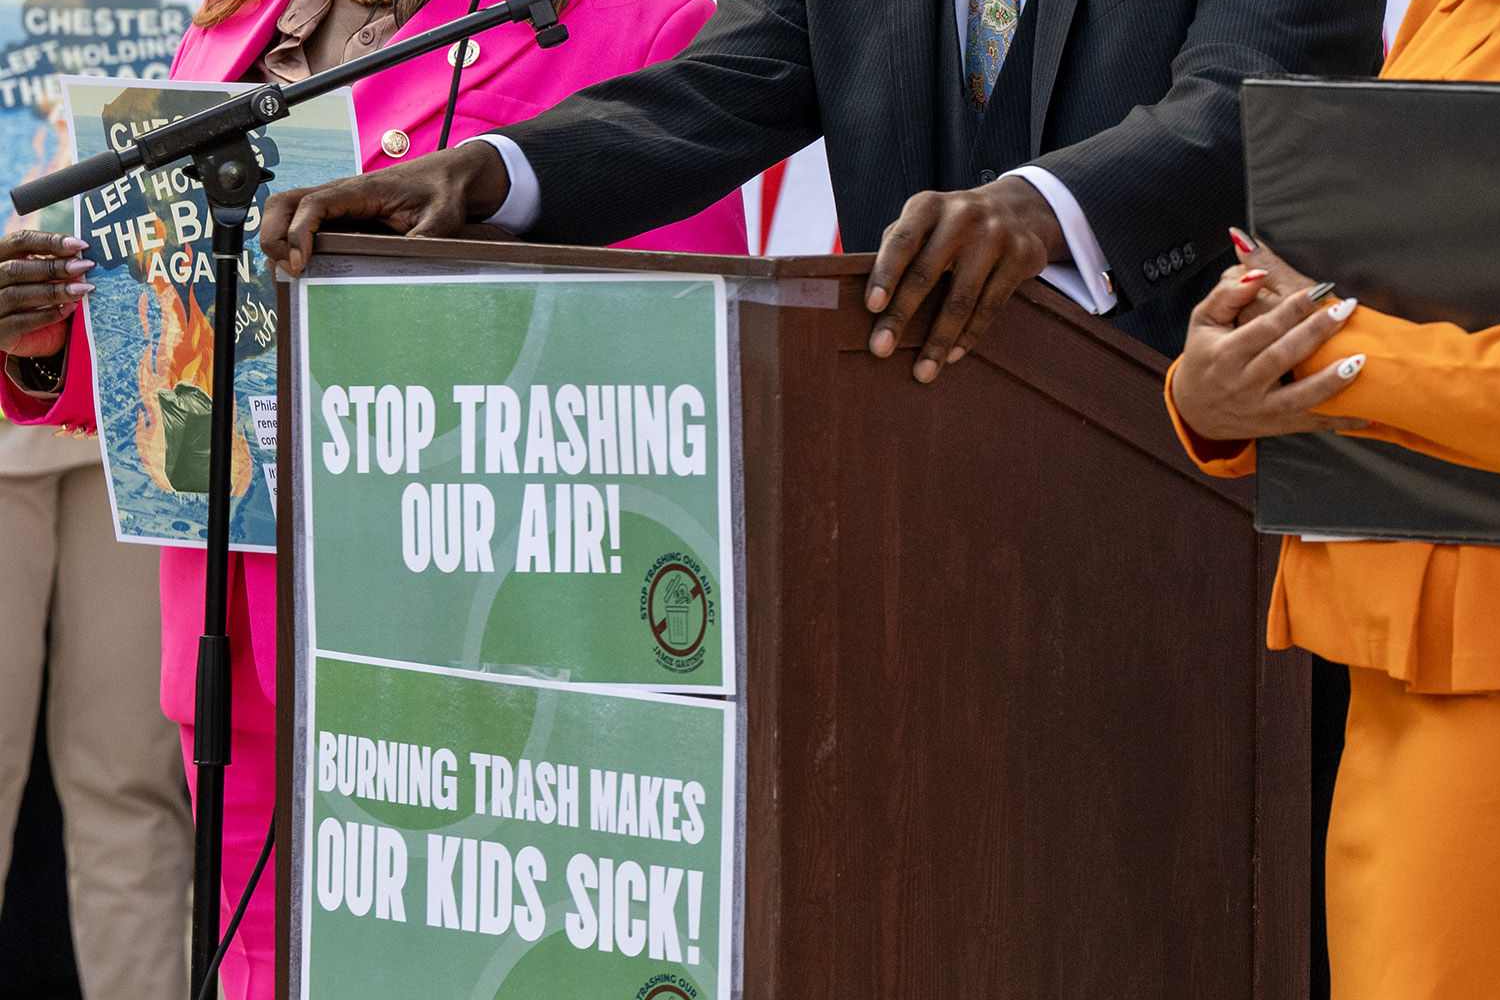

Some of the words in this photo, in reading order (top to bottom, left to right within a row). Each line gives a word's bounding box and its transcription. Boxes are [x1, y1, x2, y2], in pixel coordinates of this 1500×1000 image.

[25, 7, 184, 36] CHESTER
[85, 165, 147, 222] LEFT
[91, 212, 165, 261] THE
[170, 196, 260, 245] BG
[147, 250, 250, 283] AGAN
[254, 400, 277, 411] Phila
[257, 420, 277, 429] rene
[321, 384, 435, 475] STOP
[453, 383, 706, 476] TRASHING
[261, 437, 277, 446] con
[401, 482, 495, 573] OUR
[515, 483, 622, 574] AIR!
[640, 586, 648, 620] STOP
[645, 552, 681, 583] TRASHING
[684, 555, 701, 575] OUR
[700, 575, 712, 595] AIR
[707, 600, 715, 626] ACT
[318, 731, 458, 811] BURNING
[470, 752, 579, 828] TRASH
[590, 768, 706, 845] MAKES
[317, 817, 408, 922] OUR
[426, 833, 547, 942] KIDS
[565, 853, 703, 966] SICK!
[678, 978, 697, 998] OUR
